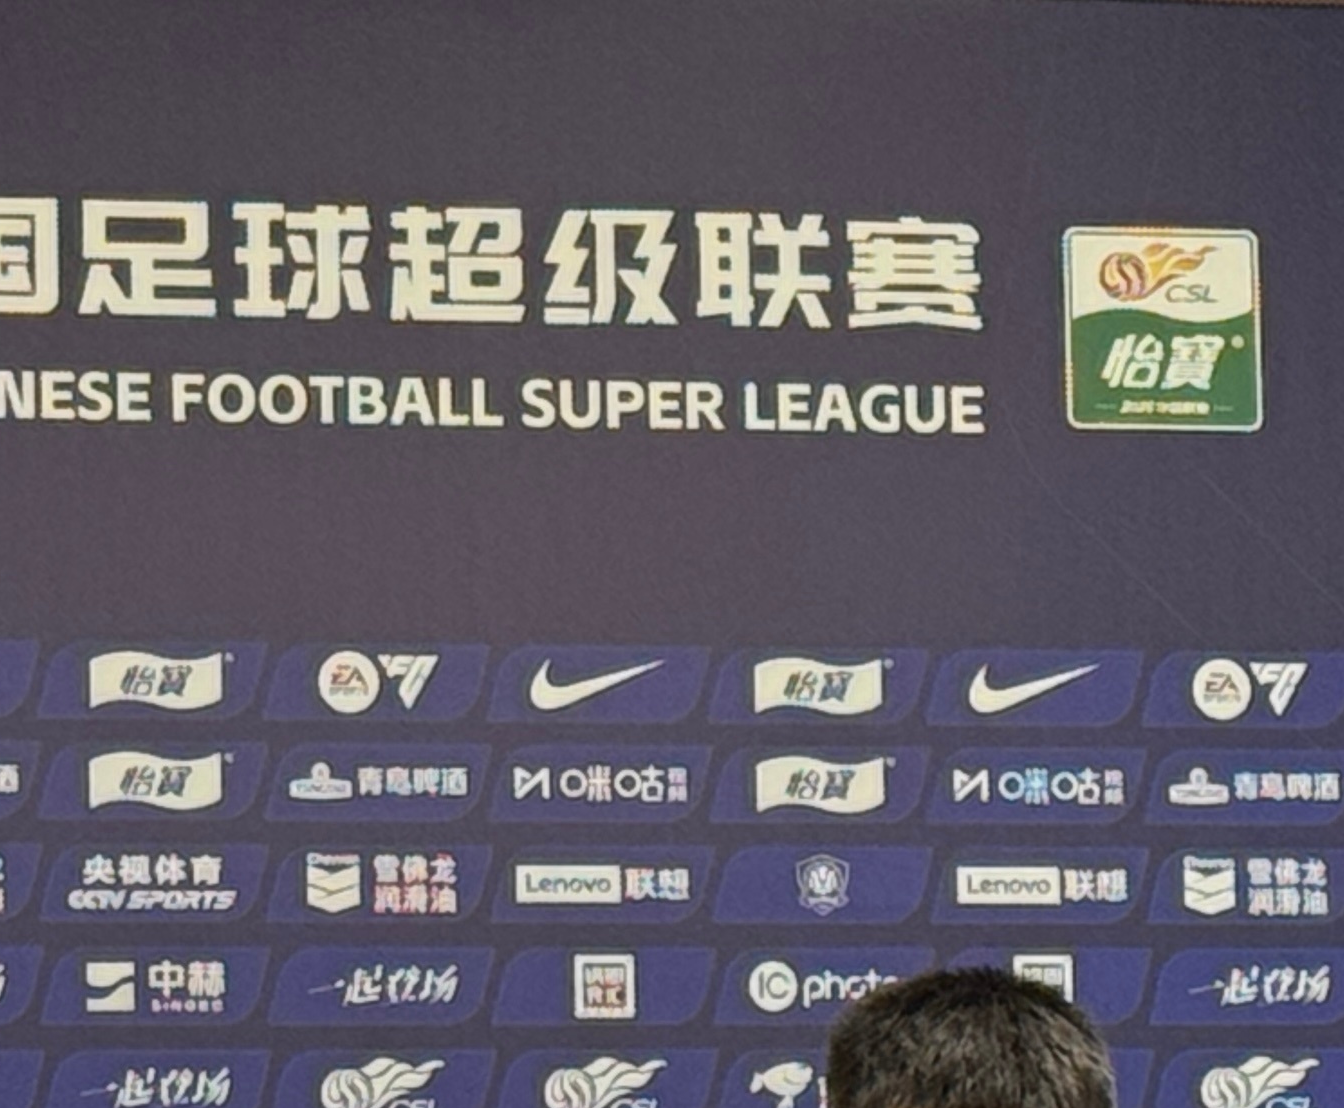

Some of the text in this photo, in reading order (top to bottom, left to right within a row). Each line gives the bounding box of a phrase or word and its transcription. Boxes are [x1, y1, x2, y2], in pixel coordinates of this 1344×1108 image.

[1164, 283, 1219, 304] CSL
[1101, 333, 1225, 390] 怡寶
[172, 373, 499, 426] FOOTBALL
[522, 379, 724, 429] SUPER
[745, 382, 984, 433] LEAGUE
[84, 854, 221, 885] 央视体育
[524, 870, 614, 896] Lenovo
[966, 873, 1053, 898] Lenovo
